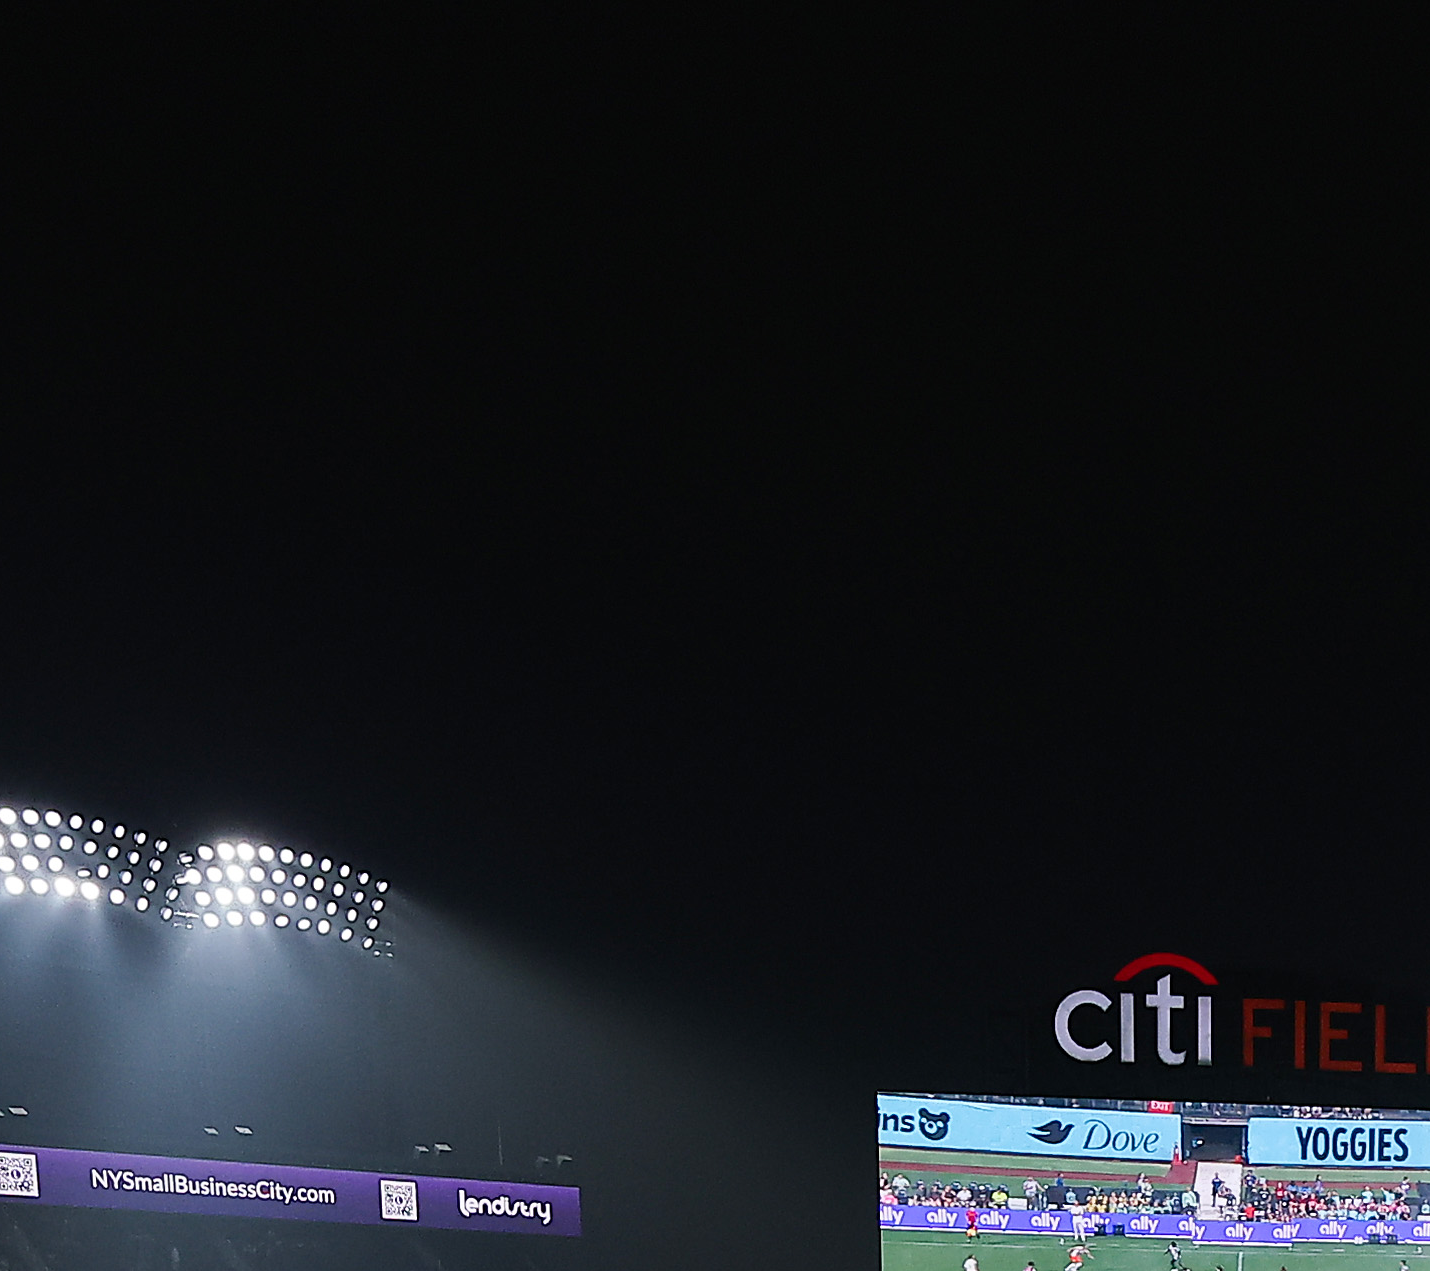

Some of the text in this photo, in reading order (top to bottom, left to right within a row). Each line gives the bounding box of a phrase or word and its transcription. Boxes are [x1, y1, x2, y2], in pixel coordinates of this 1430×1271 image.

[1055, 973, 1213, 1066] citi
[1151, 1100, 1170, 1109] EXIT
[1082, 1119, 1161, 1154] Dove
[1295, 1126, 1410, 1162] YOGGIES
[91, 1168, 336, 1206] NYSmallBusinessCity.com
[459, 1189, 553, 1227] lendistry
[927, 1208, 1348, 1241] ally ally ally ally ally ally ally ally
